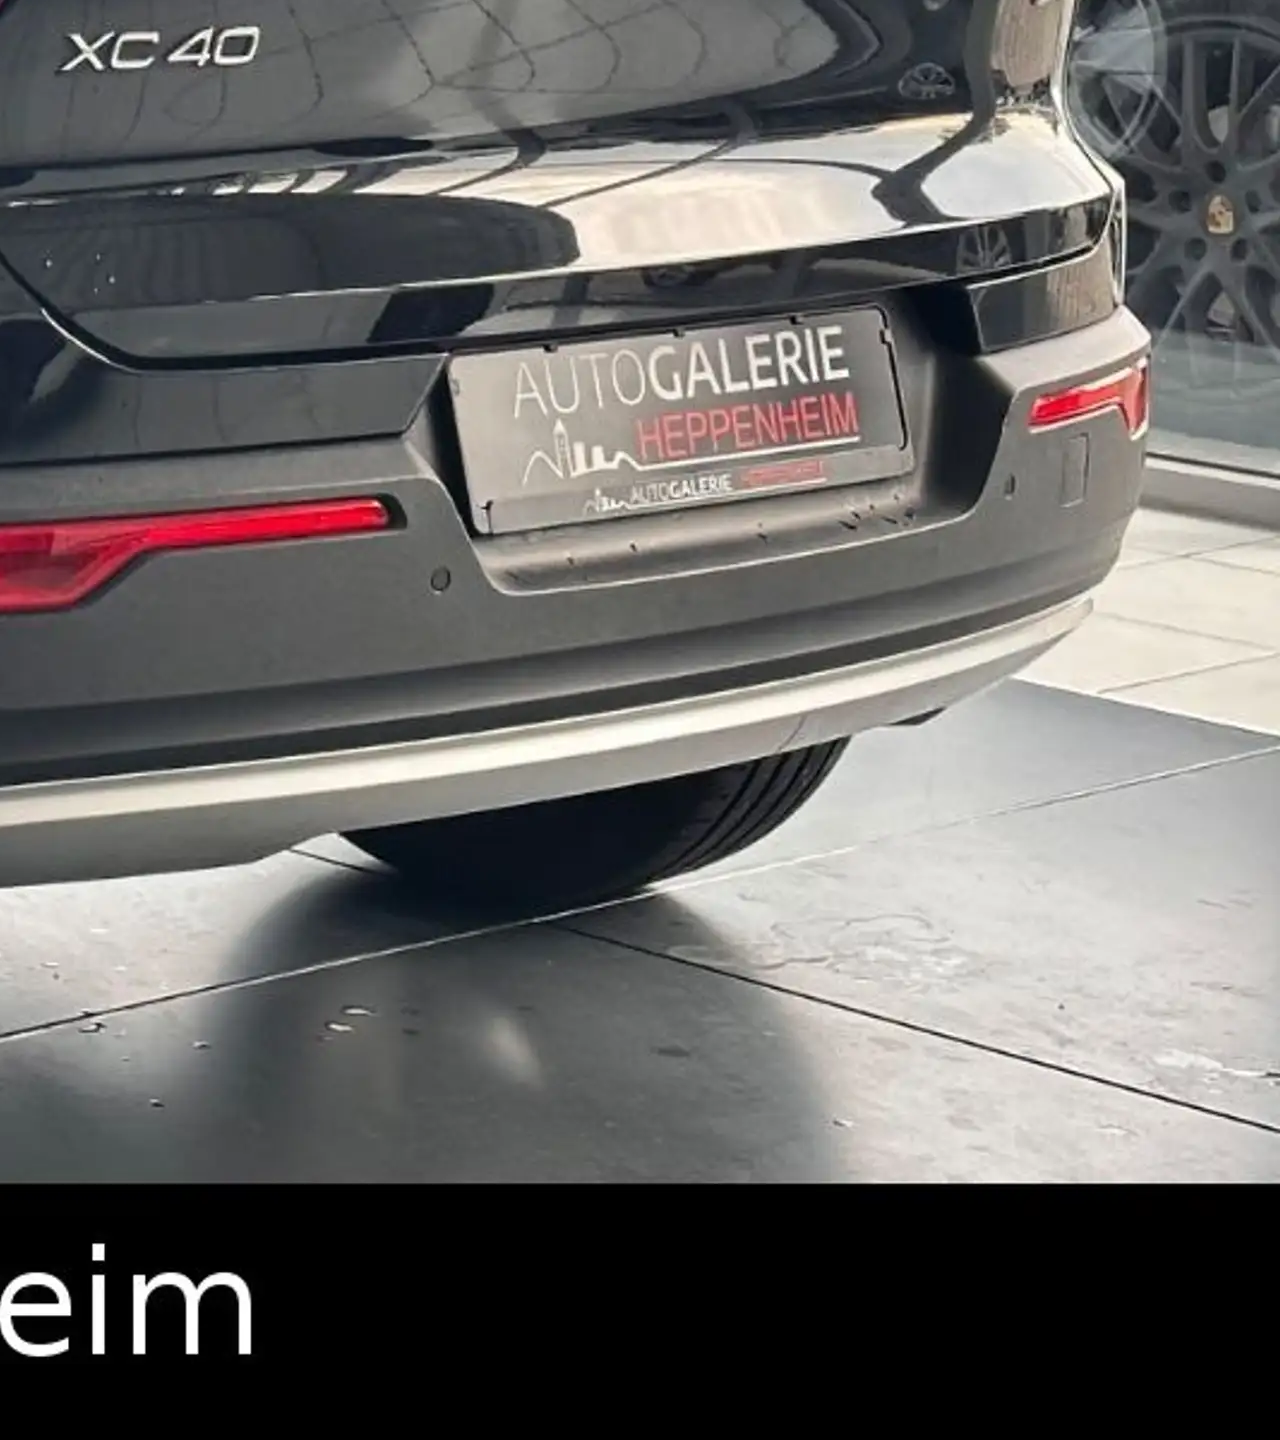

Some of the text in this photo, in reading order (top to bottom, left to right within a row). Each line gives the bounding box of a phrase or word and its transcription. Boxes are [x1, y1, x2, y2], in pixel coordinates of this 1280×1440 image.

[513, 325, 850, 418] AUTOGALERIE
[635, 391, 859, 461] HEPPENHEIM
[630, 473, 734, 502] AUTOGALERIE
